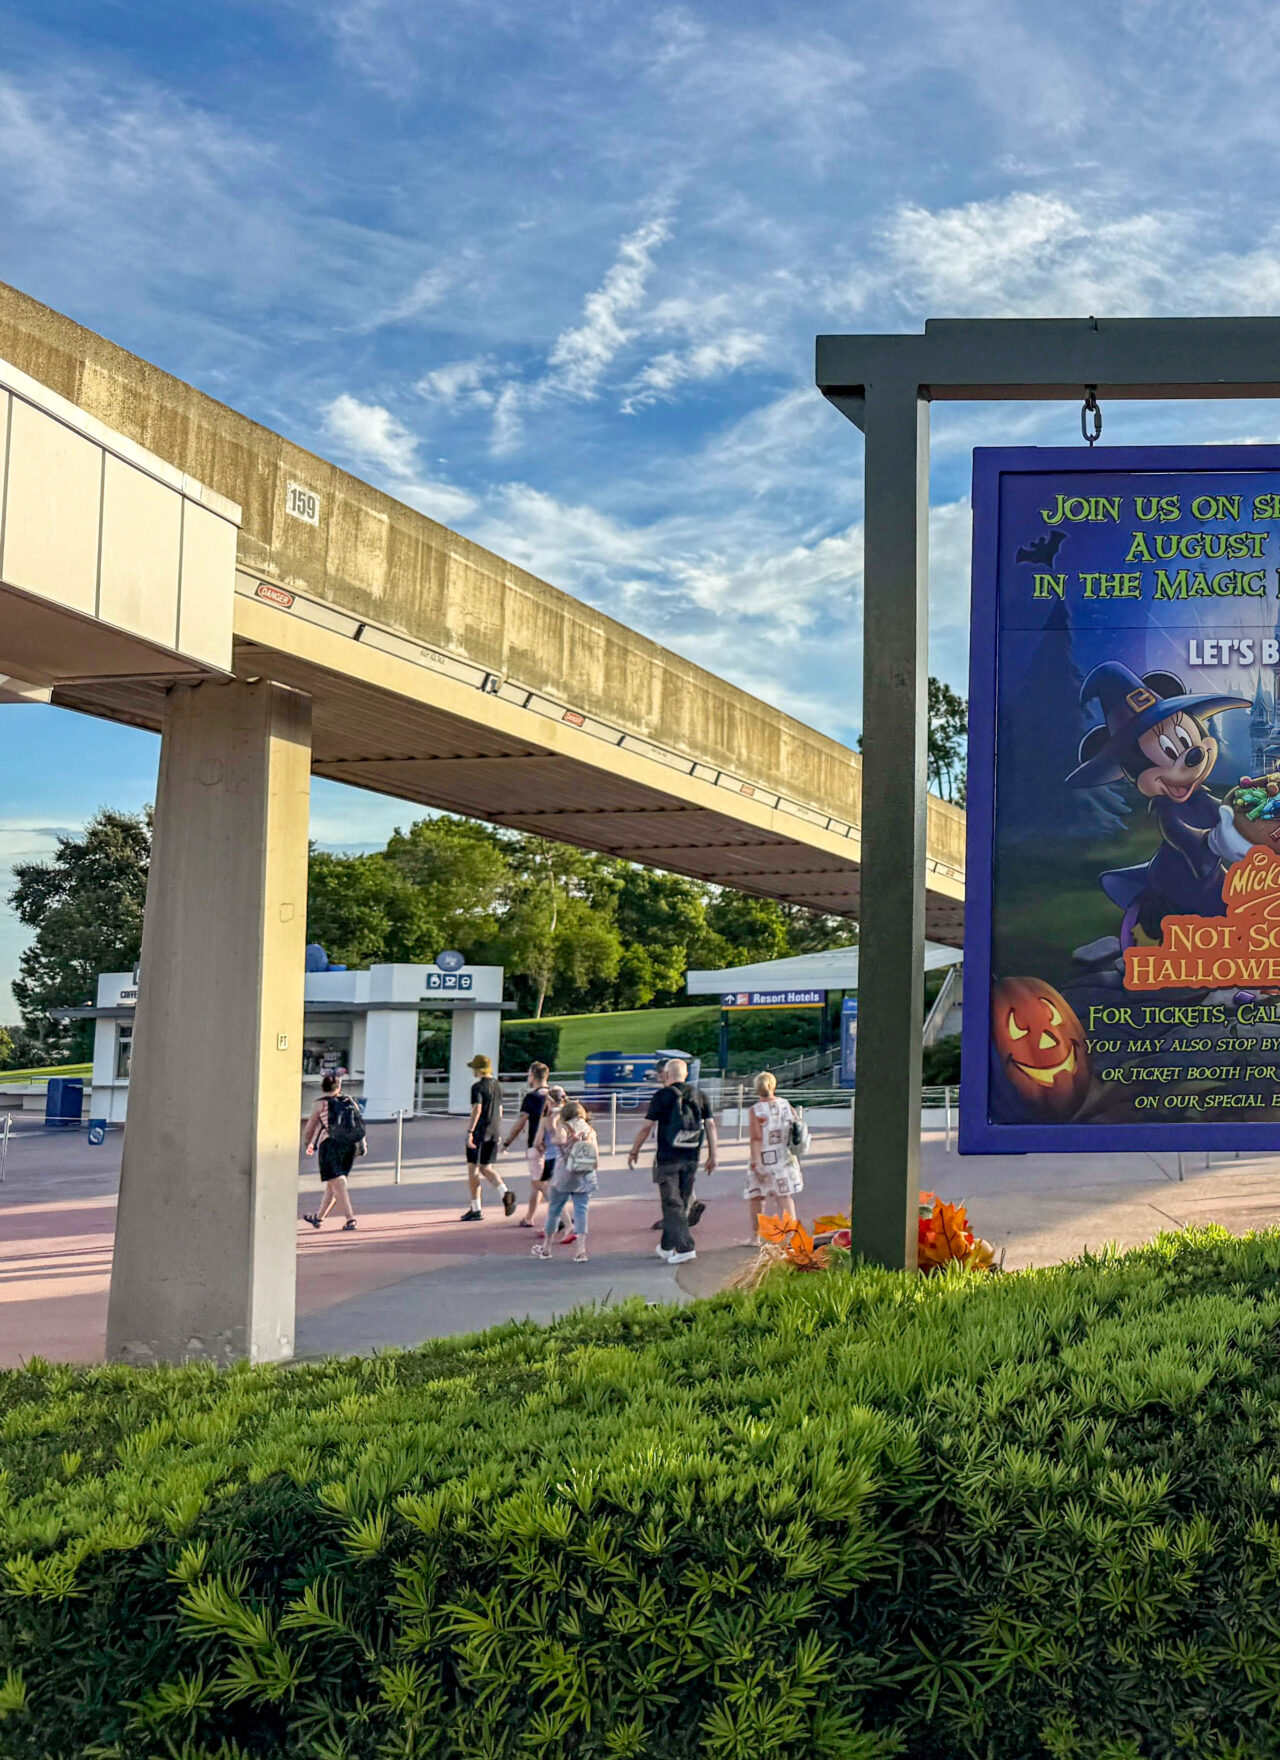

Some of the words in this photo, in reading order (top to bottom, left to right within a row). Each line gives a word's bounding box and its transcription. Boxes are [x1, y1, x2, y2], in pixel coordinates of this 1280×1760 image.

[290, 488, 316, 520] 159
[1040, 494, 1123, 526] JOIN
[1134, 493, 1182, 523] US
[1190, 495, 1244, 522] ON
[1124, 531, 1270, 563] AUGUST
[261, 586, 289, 605] DANGER
[1032, 572, 1068, 600] IN
[1079, 571, 1142, 600] THE
[1153, 568, 1267, 600] MAGIC
[1189, 638, 1255, 666] LET'S
[1168, 924, 1236, 953] NOT
[753, 993, 786, 1004] Resort
[787, 991, 820, 1002] Hotels
[1088, 1004, 1146, 1031] FOR
[1141, 1004, 1229, 1027] TICKETS,
[1085, 1039, 1121, 1054] YOU
[1127, 1039, 1165, 1053] MAY
[1170, 1038, 1212, 1053] ALSO
[1216, 1038, 1257, 1052] STOP
[1102, 1067, 1131, 1084] OR
[1131, 1066, 1182, 1083] TICKET
[1187, 1066, 1240, 1080] BOOTH
[1134, 1095, 1159, 1109] ON
[1164, 1095, 1207, 1111] OUR
[1204, 1094, 1265, 1108] SPECIAL
